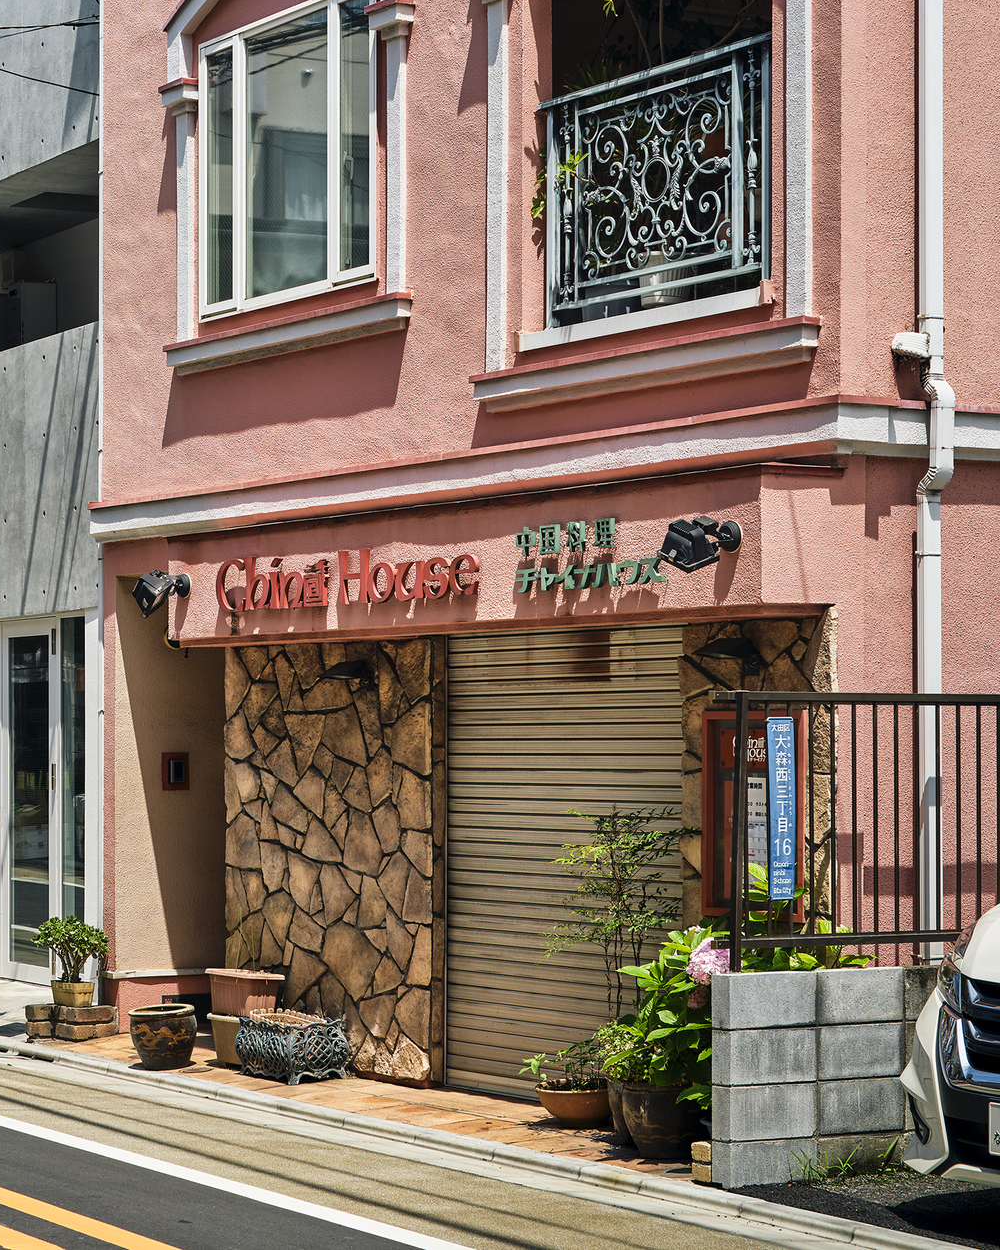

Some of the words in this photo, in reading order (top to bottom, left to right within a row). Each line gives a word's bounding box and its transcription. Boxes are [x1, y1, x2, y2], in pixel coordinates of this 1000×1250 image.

[515, 518, 616, 557] 中国料理
[338, 548, 481, 606] House
[514, 556, 667, 595] チャイナハウス
[771, 724, 790, 732] 大田区
[775, 734, 789, 833] 大森西三丁目
[774, 838, 792, 857] 16
